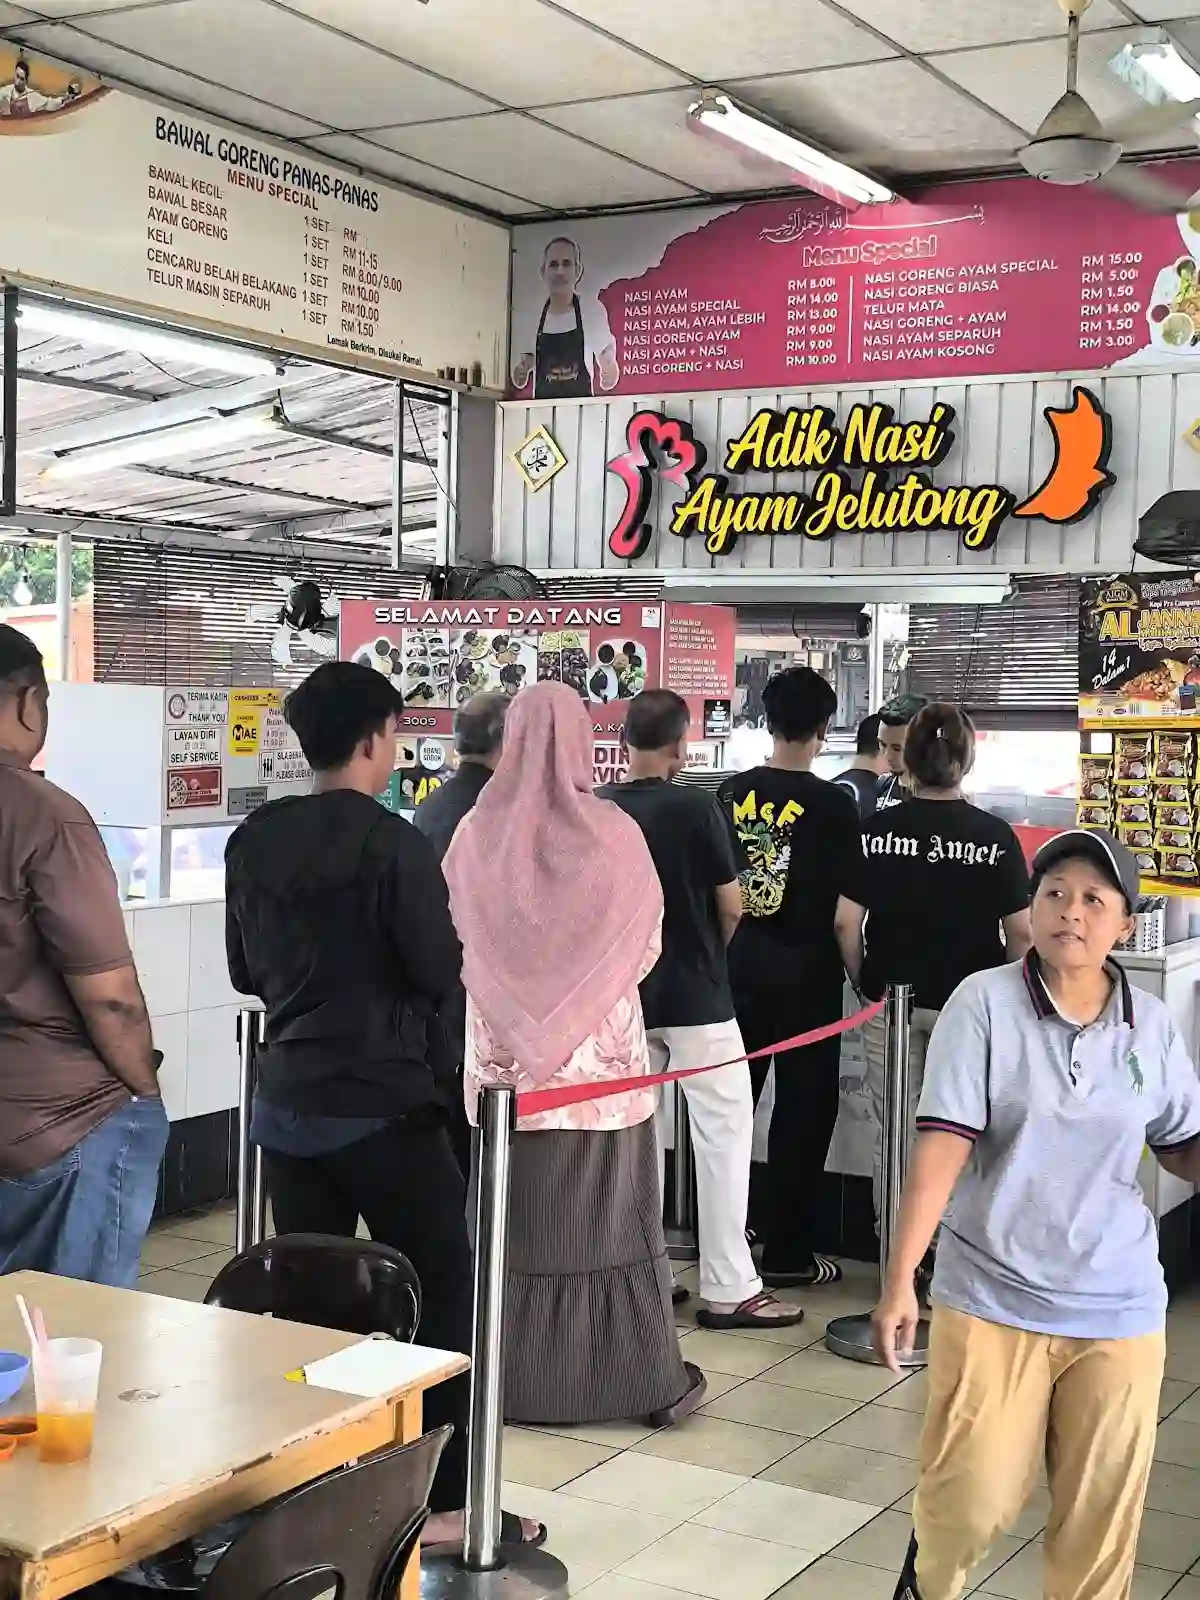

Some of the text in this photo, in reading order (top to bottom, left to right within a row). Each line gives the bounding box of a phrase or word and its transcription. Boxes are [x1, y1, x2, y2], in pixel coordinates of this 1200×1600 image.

[156, 116, 379, 212] BAWAL GORENG PANAS-PANAS
[149, 164, 223, 200] BAWAL KECIL
[227, 168, 319, 211] MENU SPECIAL
[148, 185, 227, 221] BAWAL BESAR
[148, 207, 228, 241] AYAM GORENG
[304, 215, 330, 232] 1 SET
[148, 227, 173, 245] KELI
[304, 234, 329, 251] 1 SET
[343, 228, 357, 242] RM
[343, 246, 378, 270] RM 11-15
[803, 235, 938, 268] Menu Special
[1082, 252, 1142, 267] RM 15.00
[303, 252, 329, 270] 1 SET
[147, 248, 297, 299] CENCARU BELAH BELAKANG
[342, 264, 356, 279] RM
[865, 259, 1059, 285] NASI GORENG AYAM SPECIAL
[1082, 272, 1103, 283] RM
[303, 272, 328, 289] 1 SET
[788, 278, 807, 291] RM
[147, 268, 271, 311] TELUR MASIN SEPARUH
[342, 282, 379, 304] RM 10.00
[625, 288, 688, 302] NASI AYAM
[864, 280, 998, 300] NASI GORENG BIASA
[1081, 286, 1134, 300] RM 1.50
[302, 290, 328, 308] 1 SET
[788, 292, 838, 306] RM 14.00
[864, 300, 945, 315] TELUR MATA
[302, 309, 327, 325] 1 SET
[341, 301, 379, 321] RM 10.00
[624, 300, 740, 317] NASI AYAM SPECIAL
[787, 308, 837, 321] RM 13.00
[1081, 302, 1141, 316] RM 14.00
[341, 319, 374, 338] RM 1.50
[624, 313, 765, 332] NASI AYAM, AYAM LEBIH
[787, 324, 806, 336] RM
[864, 319, 893, 331] NASI
[898, 315, 953, 329] GORENG
[968, 312, 1007, 324] AYAM
[1080, 318, 1133, 332] RM 1.50
[328, 334, 349, 348] Lemak
[624, 330, 740, 346] NASI GORENG AYAM
[786, 339, 832, 351] RM 9.00
[863, 327, 1001, 346] NASI AYAM SEPARUH
[1080, 337, 1101, 348] RM
[623, 350, 650, 361] NASI
[653, 348, 686, 359] AYAM
[699, 345, 727, 357] NASI
[786, 354, 837, 367] RM 10.00
[863, 344, 995, 362] NASI AYAM KOSONG
[623, 364, 650, 375] NASI
[652, 361, 702, 374] GORENG
[715, 359, 743, 371] NASI
[726, 405, 945, 470] Adik Nasi
[672, 471, 1006, 553] Ayam Jelutong
[375, 607, 621, 624] SELAMAT DATANG
[1099, 610, 1139, 641] AL
[1102, 648, 1117, 672] 14
[1092, 662, 1125, 690] Dalam
[188, 692, 228, 701] TERIMA KASIH
[188, 713, 225, 722] THANK YOU
[174, 730, 216, 741] LAYAN DIRI
[171, 752, 219, 763] SELF SERVICE
